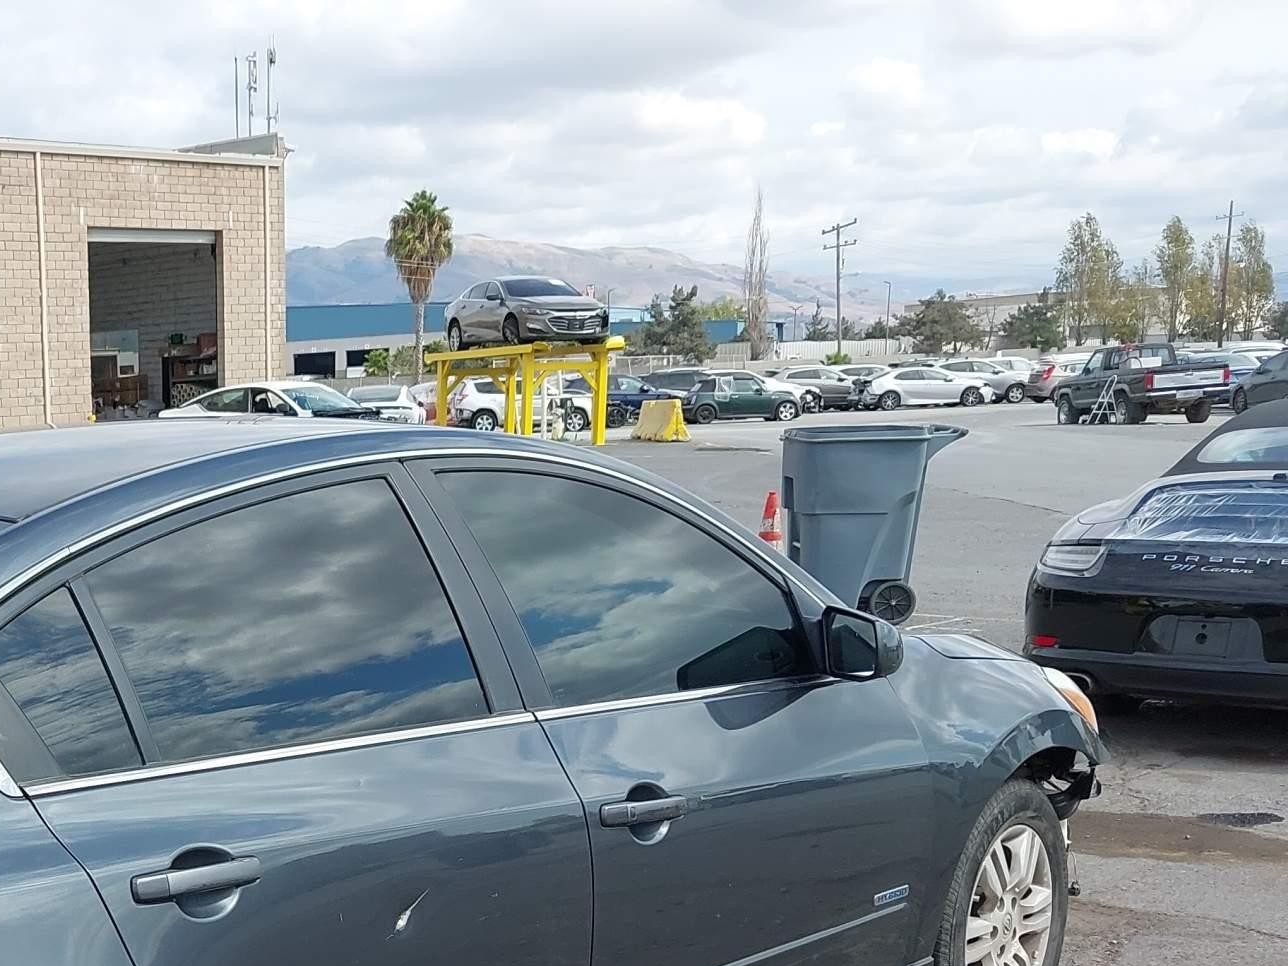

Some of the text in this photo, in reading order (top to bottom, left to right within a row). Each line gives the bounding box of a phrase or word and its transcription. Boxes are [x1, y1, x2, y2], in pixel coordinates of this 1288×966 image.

[1142, 554, 1288, 566] PORSCHE
[1170, 563, 1256, 575] 911 Carrera
